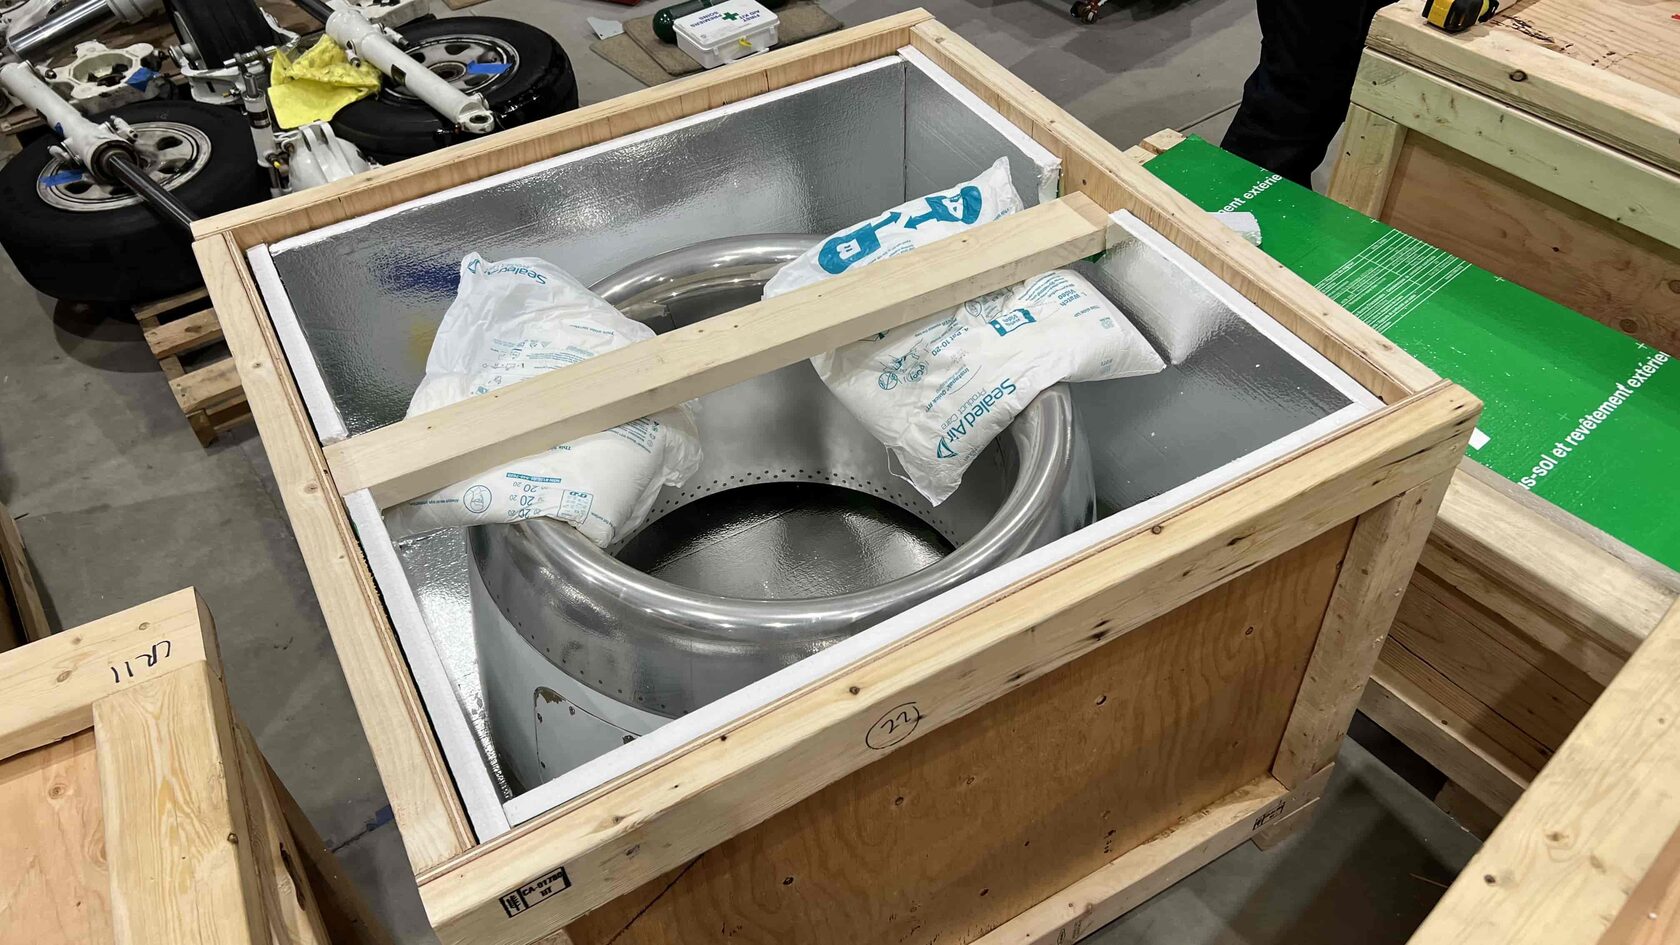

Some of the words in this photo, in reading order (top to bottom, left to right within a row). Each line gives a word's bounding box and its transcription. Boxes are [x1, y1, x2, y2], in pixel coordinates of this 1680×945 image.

[690, 14, 722, 28] PREMIERS
[699, 11, 719, 20] SOINS
[743, 14, 760, 22] FIRST
[836, 239, 861, 260] B
[1059, 293, 1081, 307] Watch
[931, 340, 951, 357] 10-20
[958, 387, 987, 414] Product
[963, 378, 1017, 428] Sealed
[941, 413, 959, 431] Care
[1552, 442, 1573, 458] et
[1565, 382, 1634, 446] revêtement
[946, 419, 967, 442] Air
[520, 495, 535, 506] 20
[880, 711, 911, 734] 22
